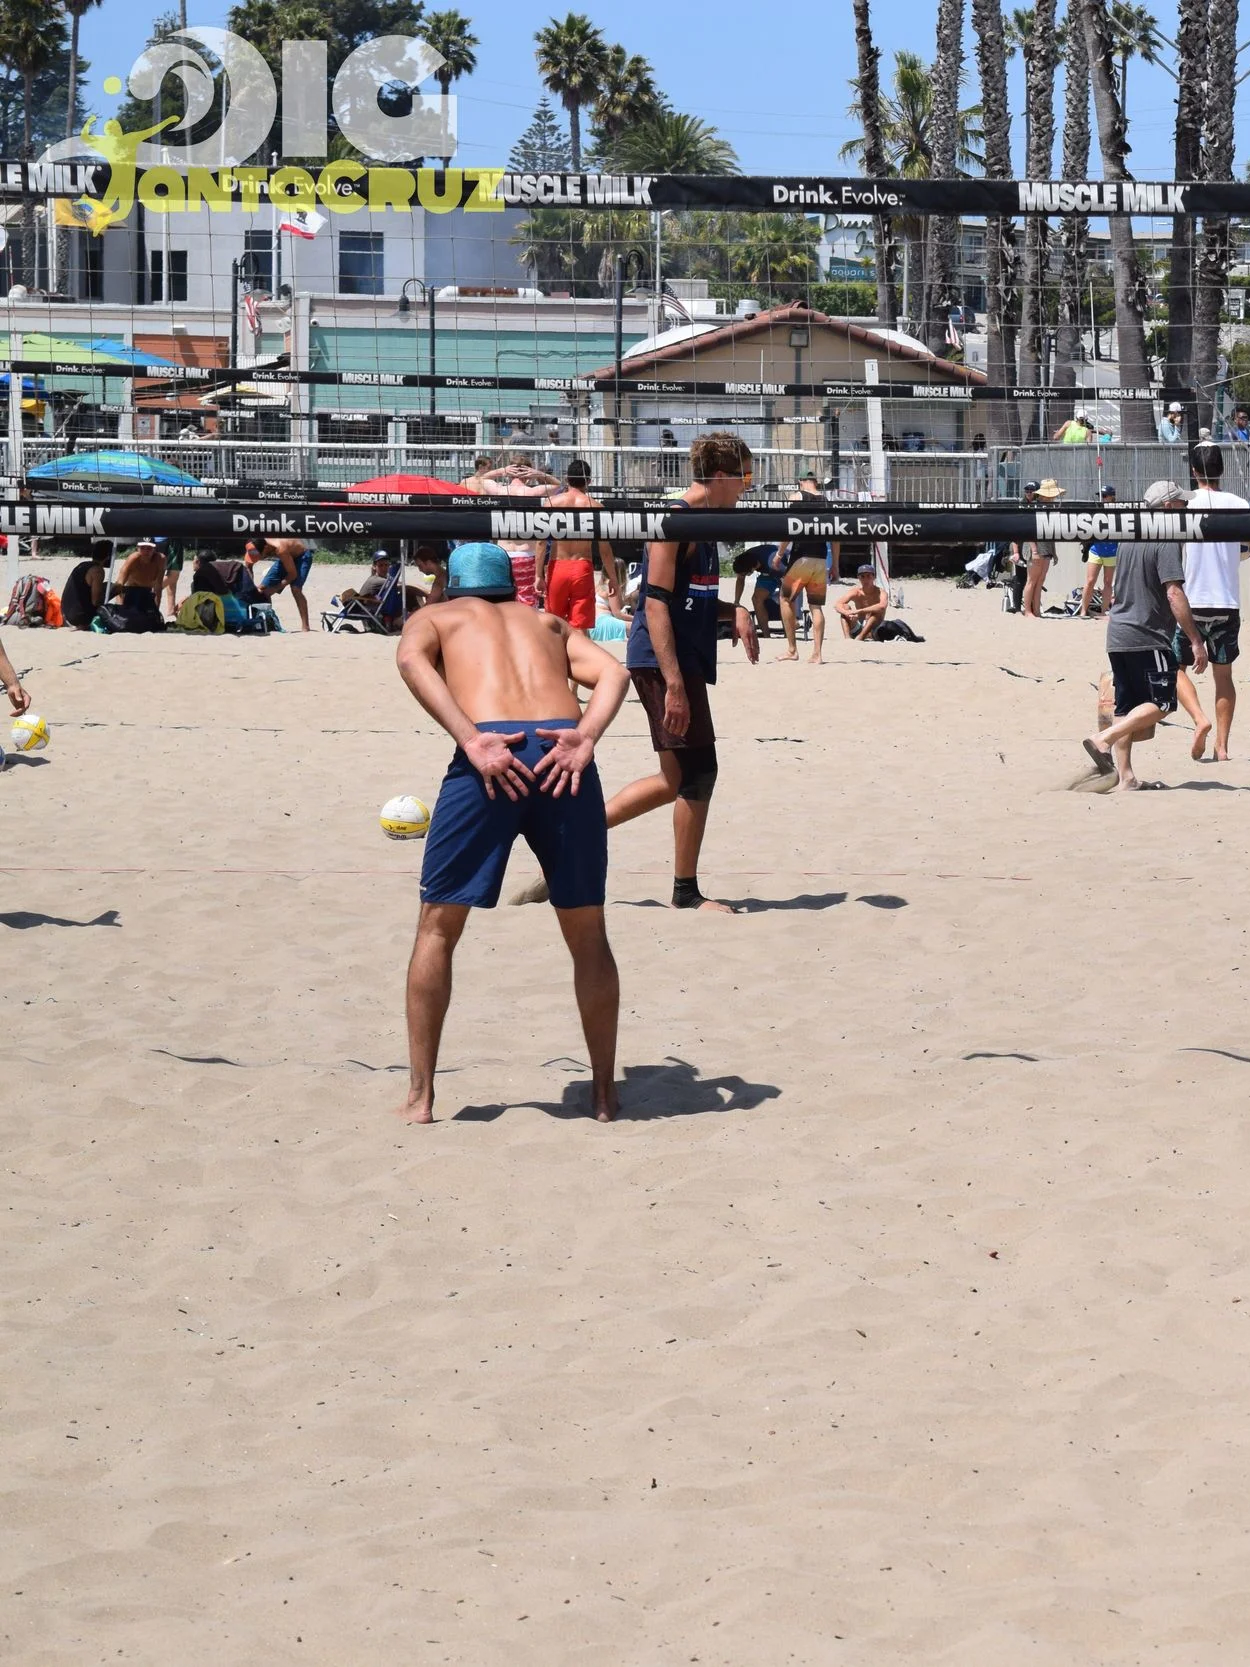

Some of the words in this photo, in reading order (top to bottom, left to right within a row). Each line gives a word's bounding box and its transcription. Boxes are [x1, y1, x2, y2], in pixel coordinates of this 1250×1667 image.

[28, 163, 97, 193] MILK
[479, 173, 581, 204] MUSCLE
[587, 175, 653, 205] MILK
[774, 185, 838, 205] Drink.
[1019, 183, 1117, 211] MUSCLE
[1123, 183, 1186, 213] MILK
[831, 268, 875, 278] aquaris
[147, 366, 185, 377] MUSCLE
[187, 367, 210, 379] MILK
[342, 373, 379, 385] MUSCLE
[380, 374, 403, 386] MILK
[535, 379, 571, 390] MUSCLE
[572, 380, 596, 391] MILK
[725, 383, 761, 394] MUSCLE
[762, 384, 786, 395] MILK
[913, 385, 949, 397] MUSCLE
[950, 387, 973, 398] MILK
[1099, 388, 1134, 399] MUSCLE
[1135, 389, 1158, 400] MILK
[153, 485, 190, 497] MUSCLE
[191, 486, 216, 498] MILK
[348, 493, 385, 504] MUSCLE
[386, 494, 410, 505] MILK
[36, 504, 105, 535] MILK
[232, 514, 301, 533] Drink.
[491, 511, 594, 539] MUSCLE
[600, 511, 666, 540] MILK
[1036, 512, 1135, 540] MUSCLE
[1141, 512, 1204, 540] MILK
[788, 517, 854, 537] Drink.
[685, 598, 693, 611] 2
